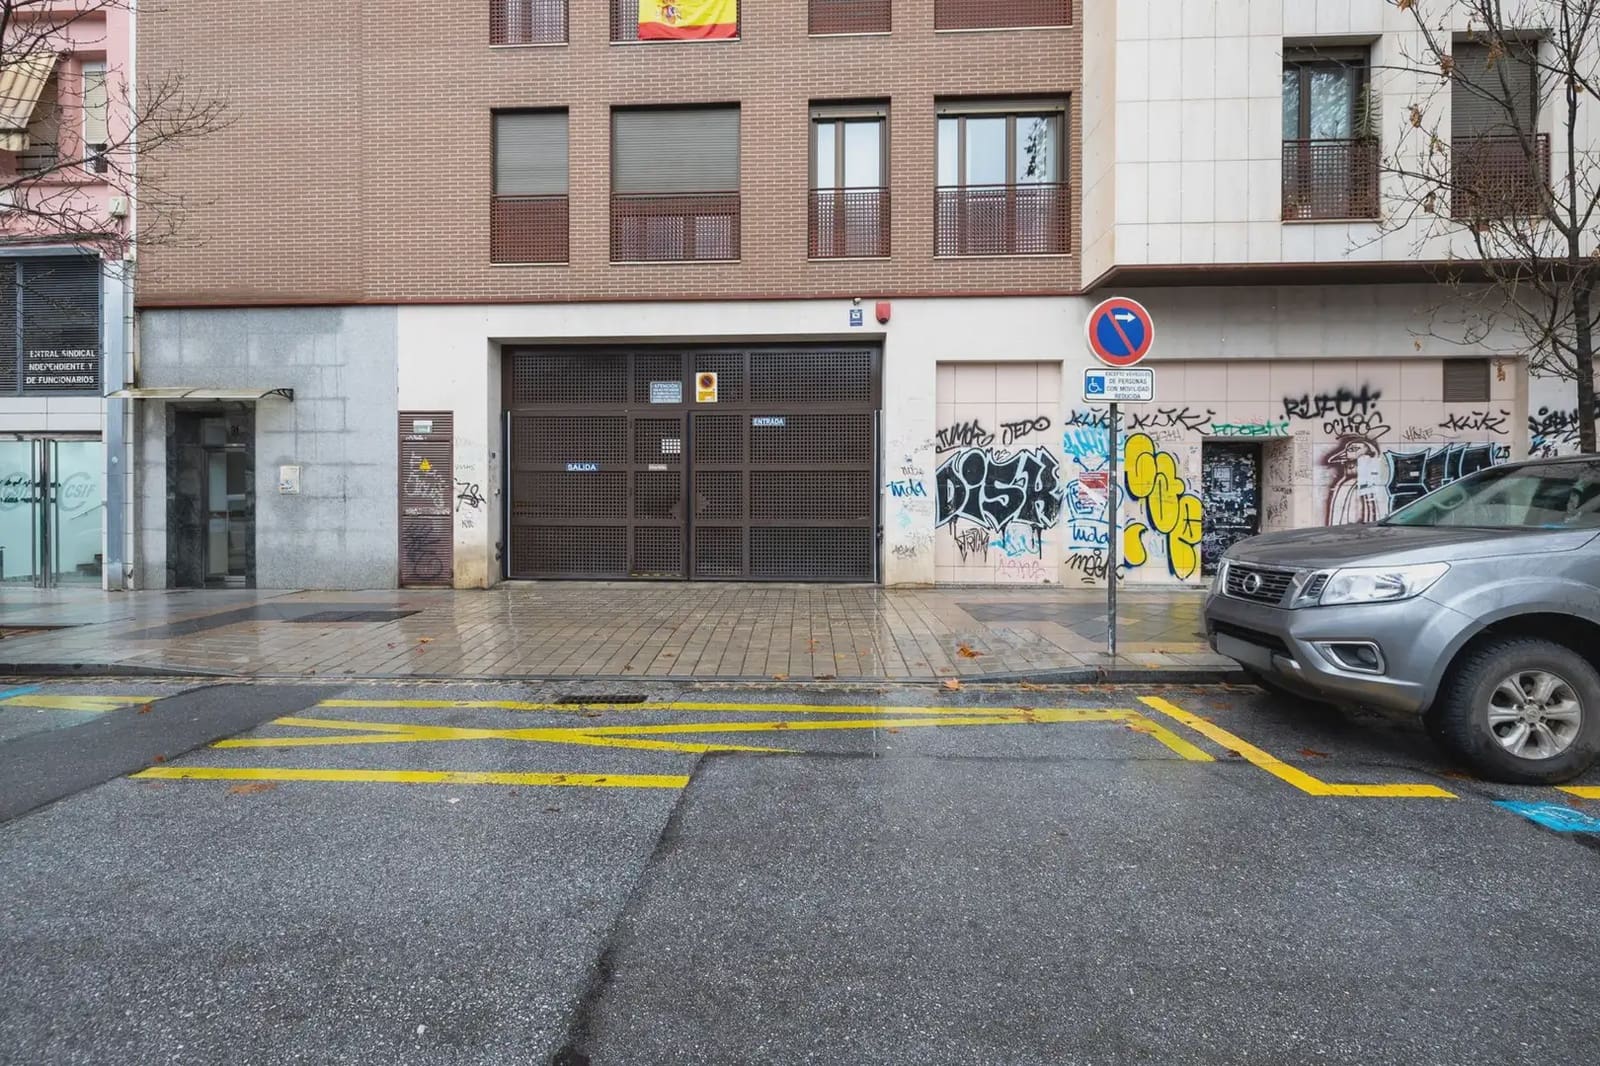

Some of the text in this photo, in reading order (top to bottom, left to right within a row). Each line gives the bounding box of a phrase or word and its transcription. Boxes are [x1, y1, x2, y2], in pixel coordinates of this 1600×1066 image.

[61, 349, 95, 357] SINDICAL
[88, 362, 93, 370] Y
[26, 375, 94, 384] DE FUNCIONARIOS
[753, 417, 784, 426] ENTRADA
[567, 463, 597, 471] SALIDA
